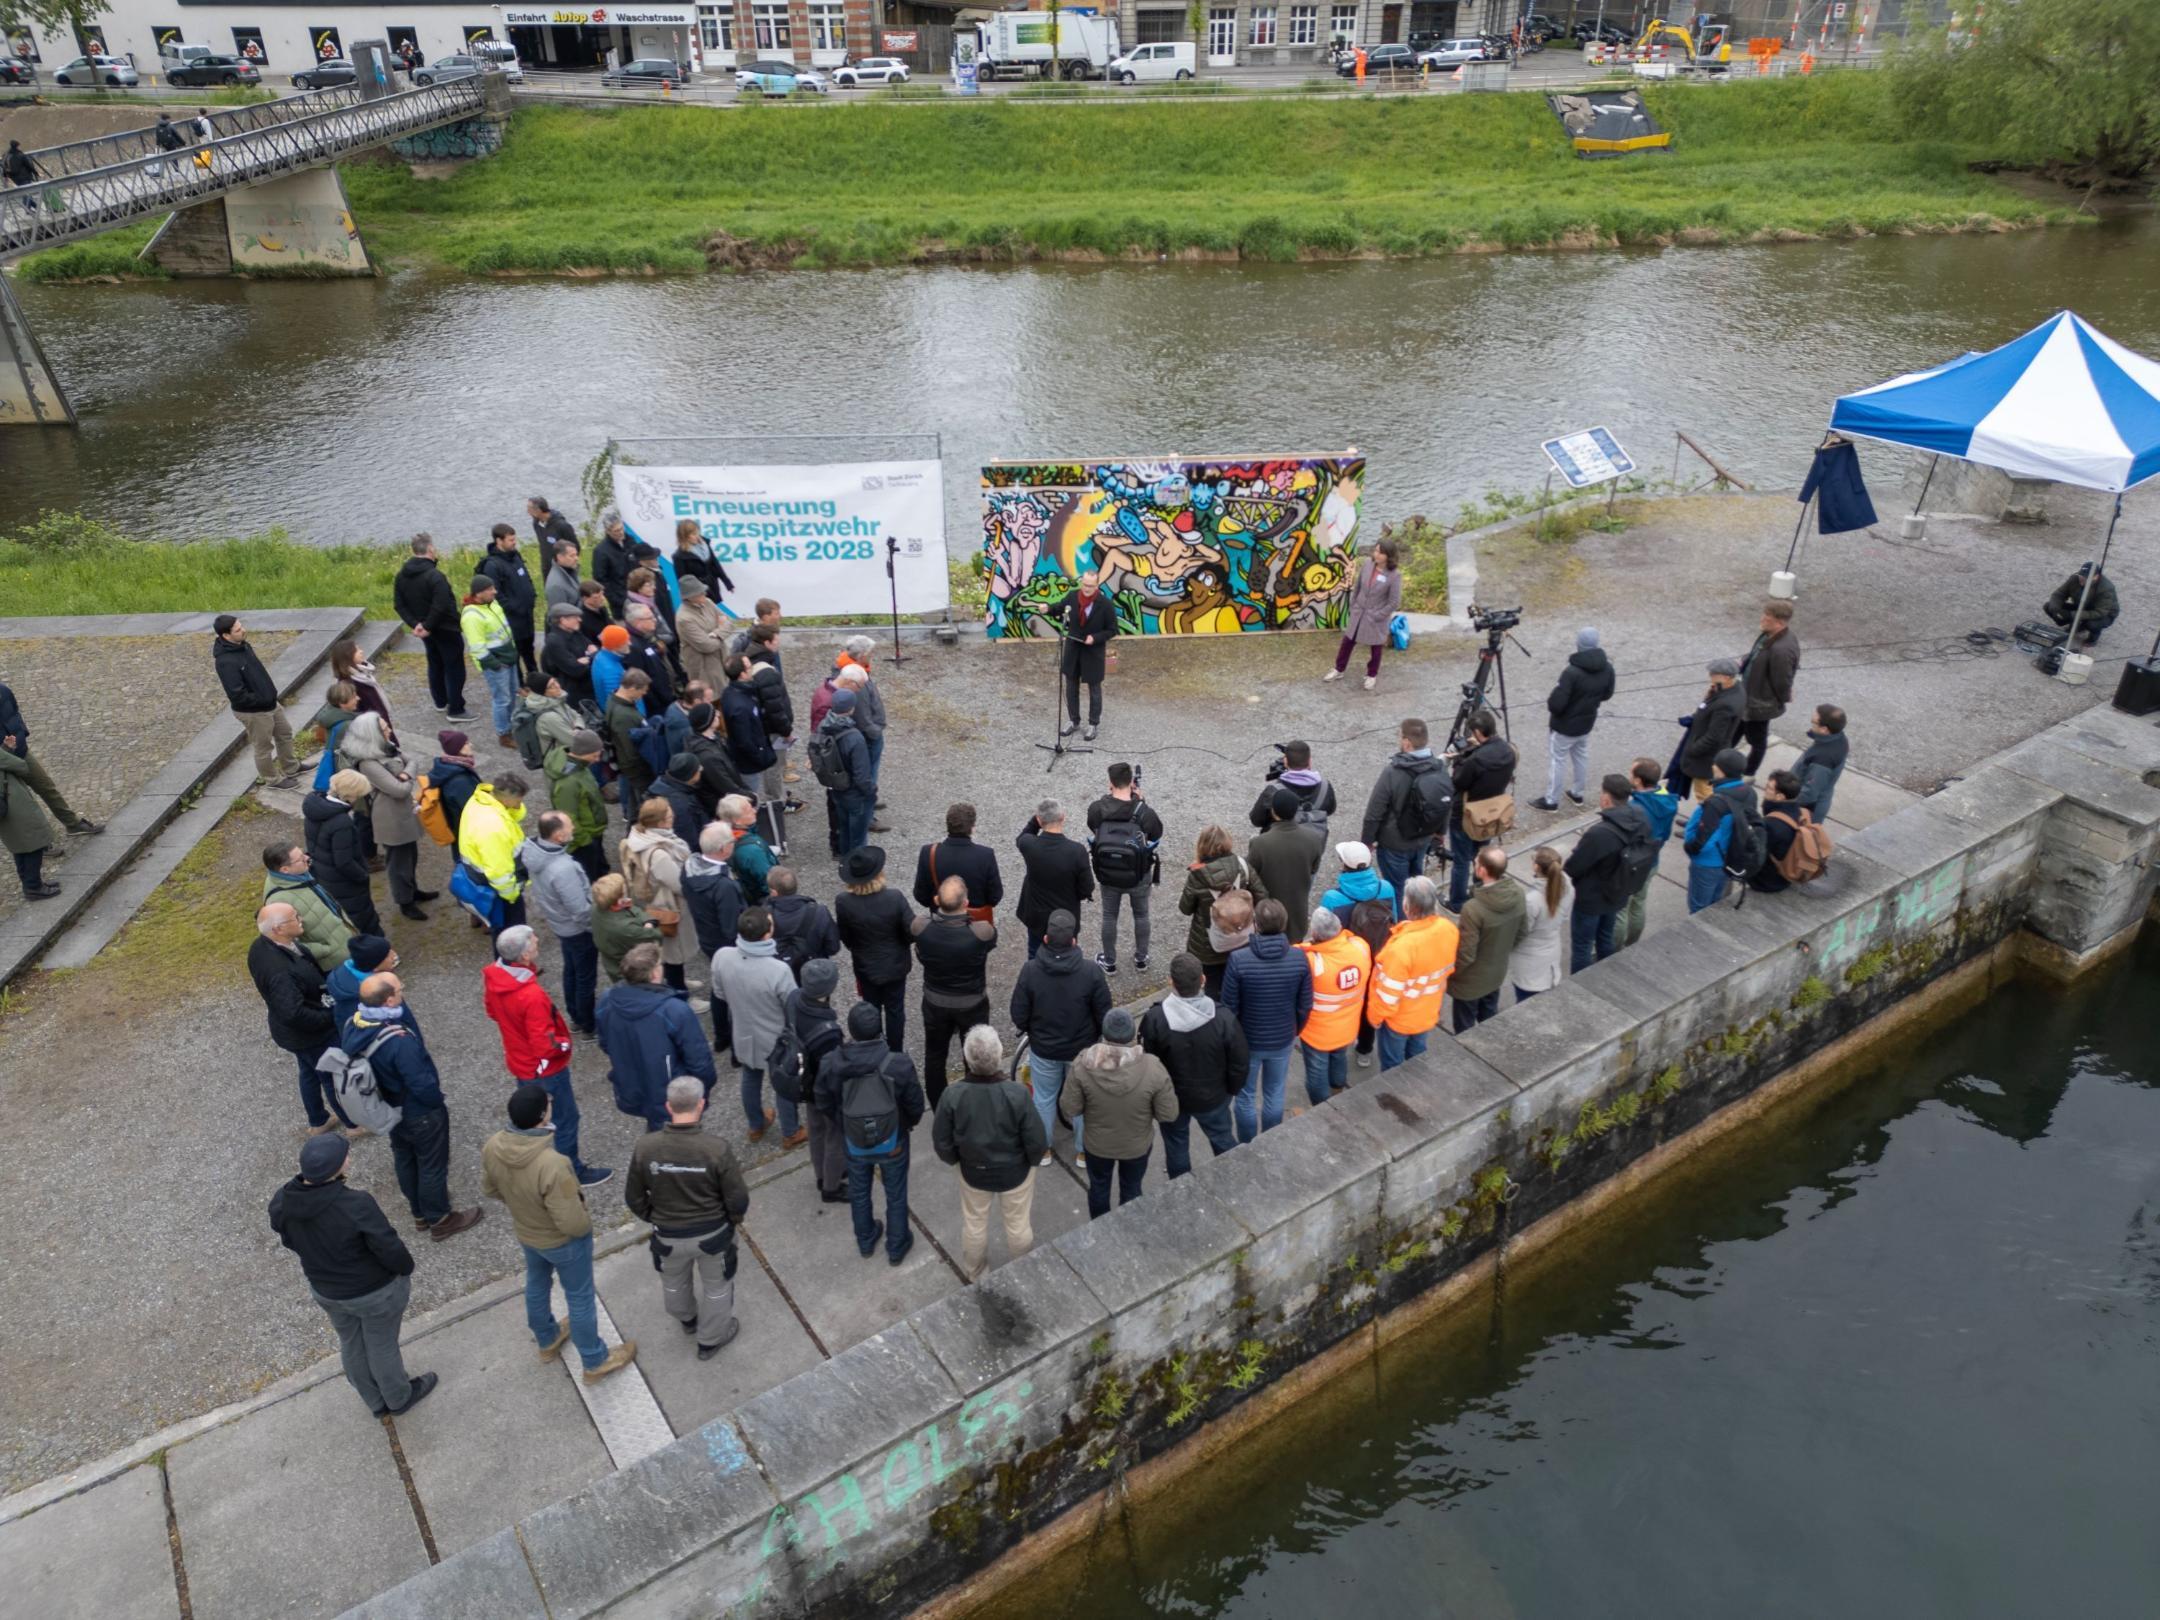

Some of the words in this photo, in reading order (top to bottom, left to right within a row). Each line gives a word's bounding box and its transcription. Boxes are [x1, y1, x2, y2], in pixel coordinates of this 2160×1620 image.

[507, 13, 547, 22] Einfahrt
[616, 13, 685, 22] Waschstrasse
[672, 495, 836, 517] Erneuerung
[674, 516, 881, 541] atzspitzwehr
[714, 542, 751, 562] 24
[758, 541, 797, 561] bis
[805, 540, 874, 560] 2028
